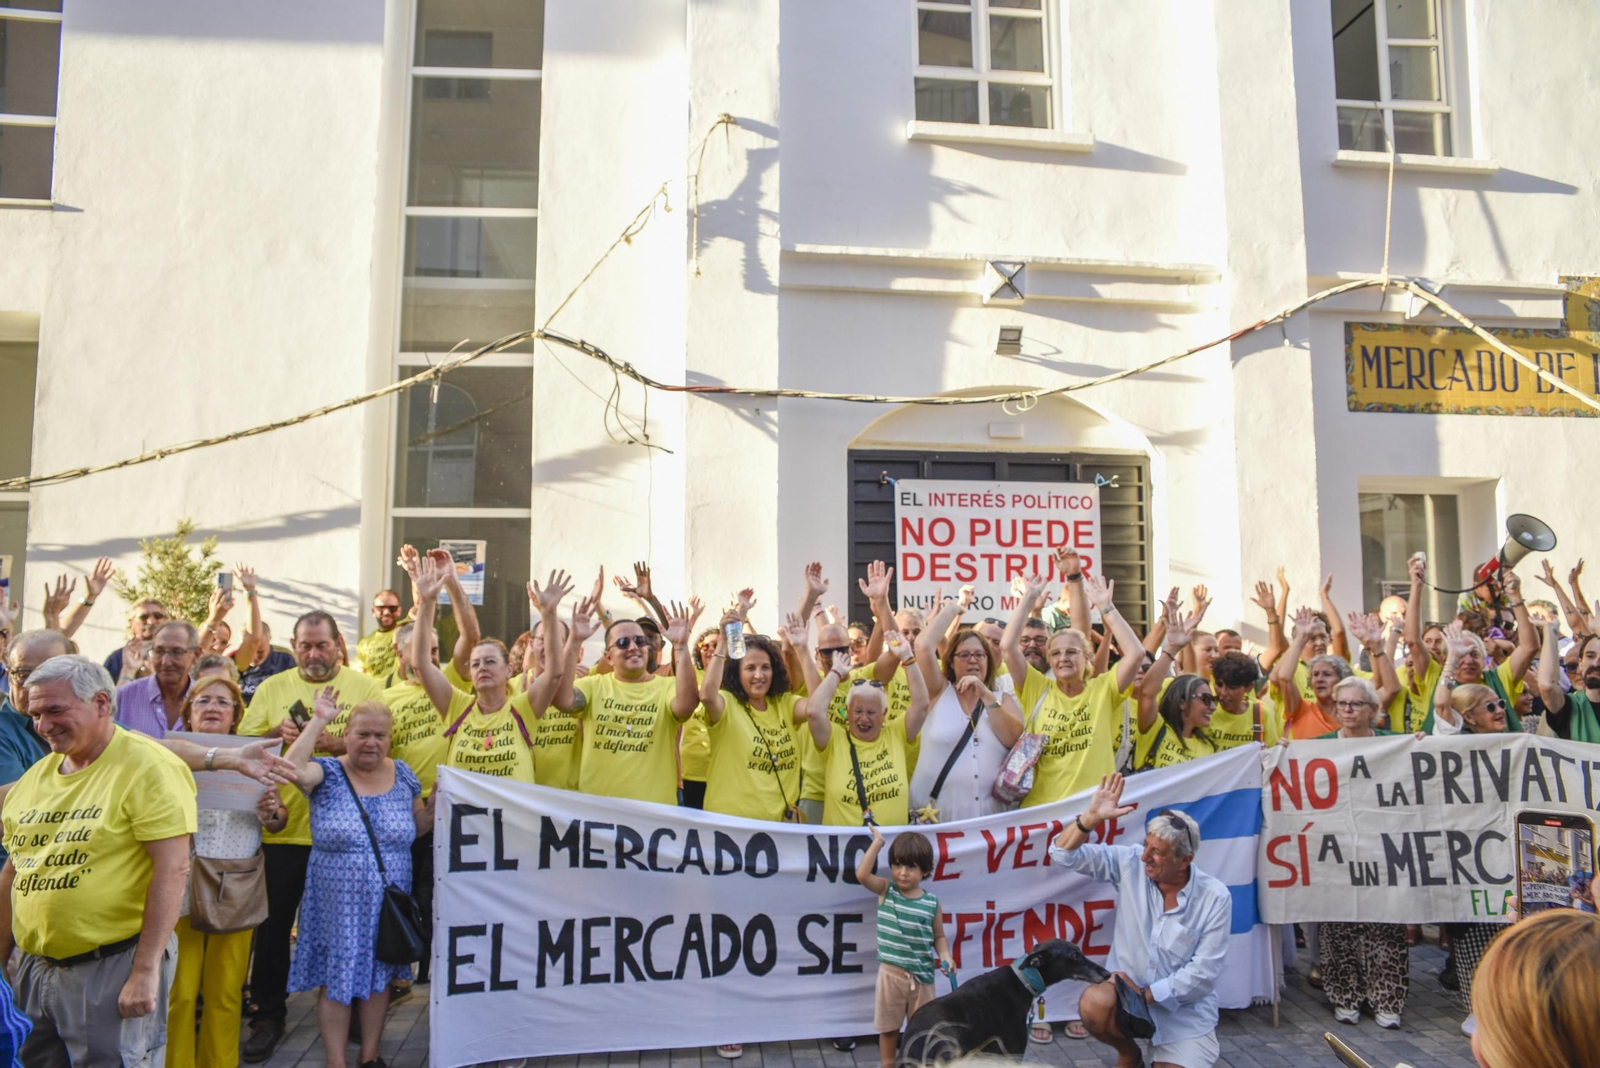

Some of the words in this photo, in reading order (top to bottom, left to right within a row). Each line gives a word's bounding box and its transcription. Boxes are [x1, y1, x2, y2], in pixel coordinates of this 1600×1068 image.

[1360, 345, 1520, 393] MERCADO
[1535, 351, 1577, 394] DE
[901, 492, 923, 506] EL
[928, 490, 1006, 508] INTERÉS
[1012, 491, 1093, 510] POLÍTICO
[901, 517, 956, 547] NO
[969, 518, 1095, 549] PUEDE
[902, 552, 1094, 583] DESTRUR
[903, 595, 994, 611] NUERO
[595, 724, 606, 735] El
[596, 713, 610, 722] no
[612, 715, 625, 724] se
[465, 750, 517, 764] mercado
[865, 773, 899, 793] ercado
[1269, 758, 1339, 811] NO
[1350, 755, 1372, 779] A
[1376, 782, 1410, 807] LA
[31, 834, 49, 847] se
[54, 826, 92, 843] ende
[449, 803, 518, 873] EL
[538, 816, 780, 879] MERCADO
[805, 834, 878, 886] NO
[1266, 822, 1314, 888] SÍ
[1317, 834, 1344, 864] A
[1349, 861, 1380, 886] UN
[447, 923, 518, 997] EL
[535, 913, 778, 989] MERCADO
[797, 913, 863, 976] SE
